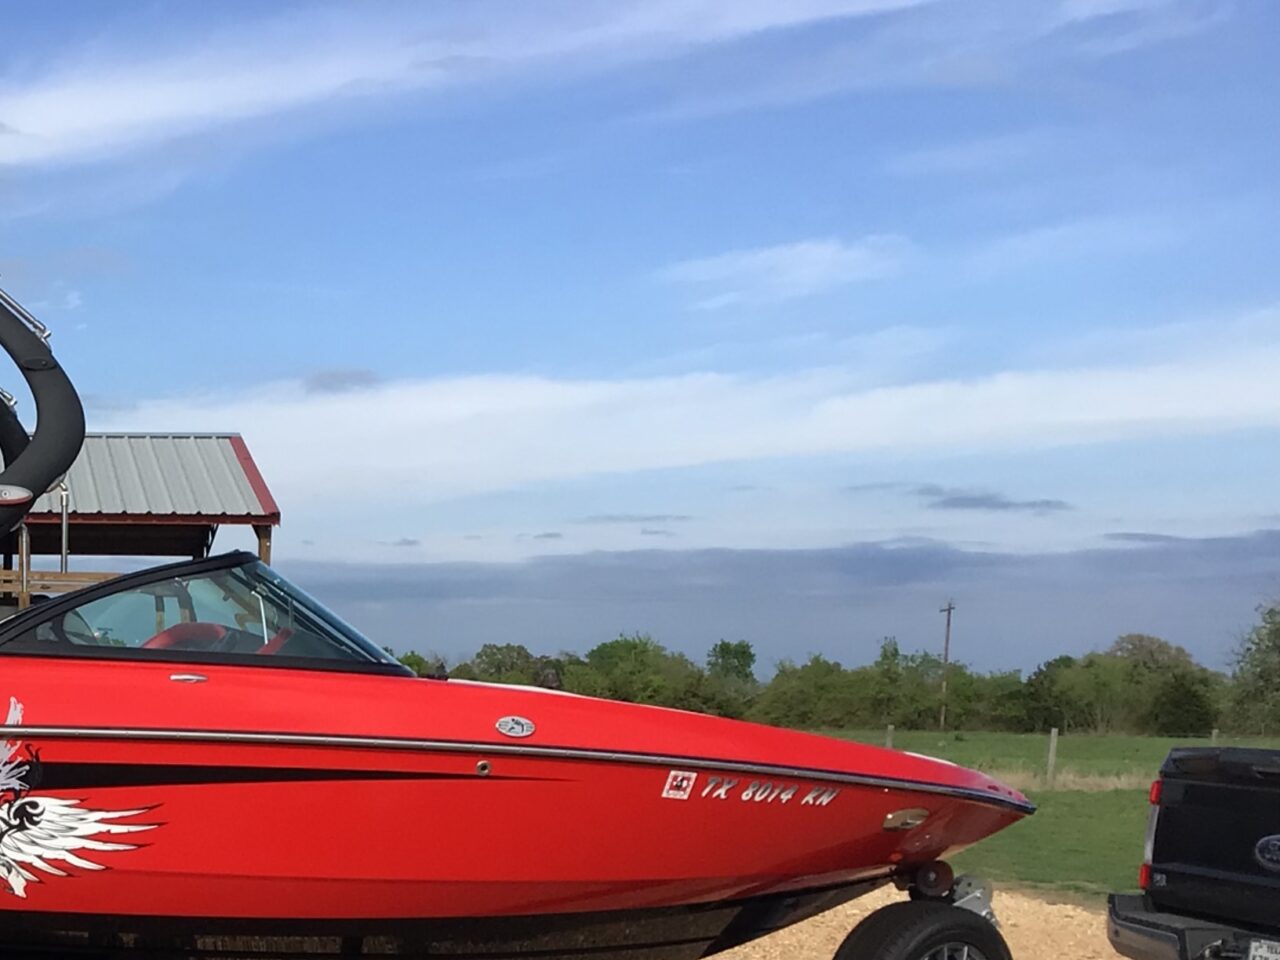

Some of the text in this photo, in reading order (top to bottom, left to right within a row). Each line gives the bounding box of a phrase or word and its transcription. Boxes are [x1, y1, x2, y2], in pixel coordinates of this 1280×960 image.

[701, 776, 739, 799] TX
[741, 780, 799, 804] 8014
[801, 784, 841, 806] KN
